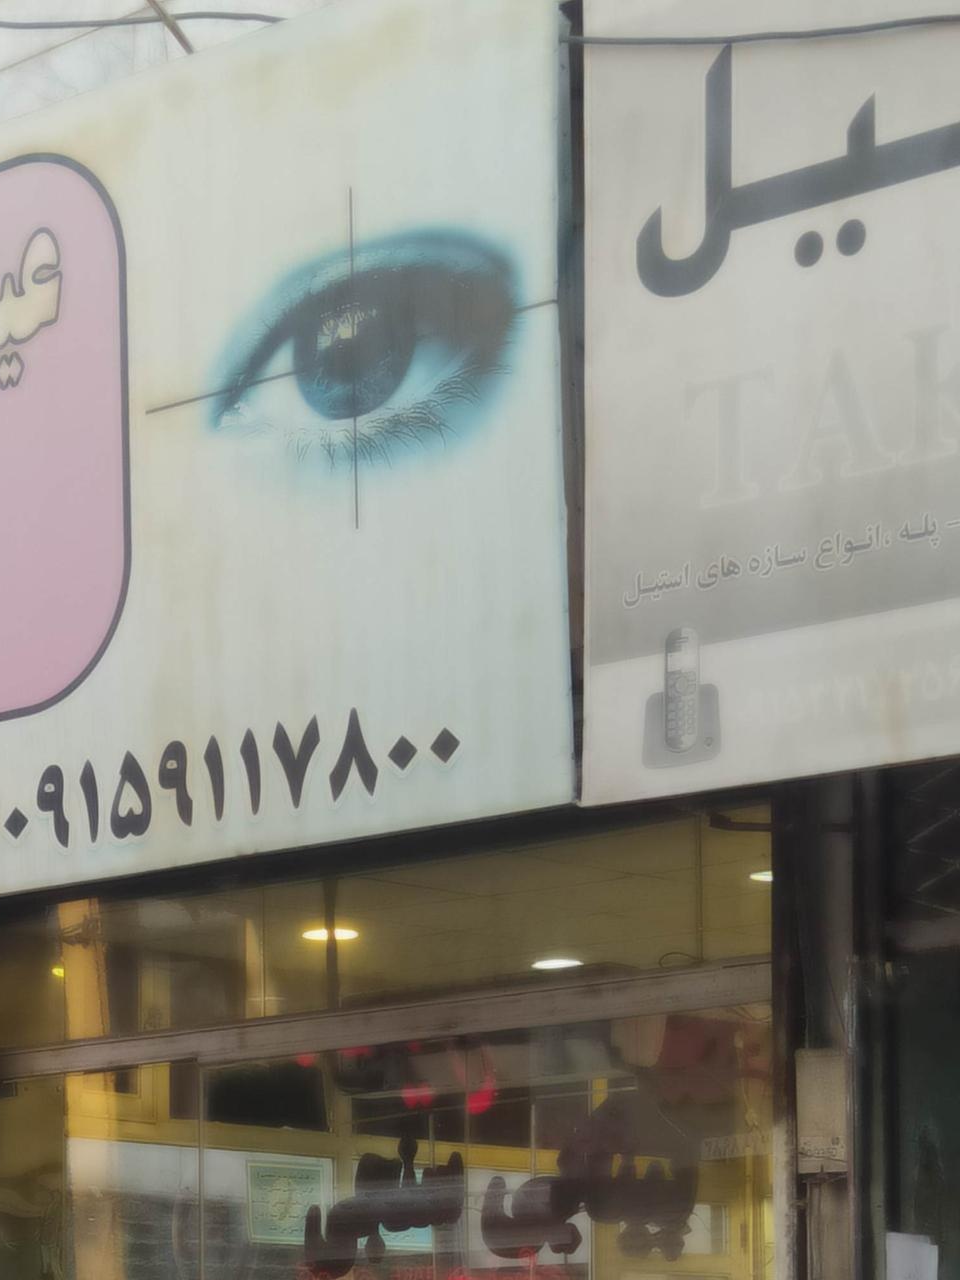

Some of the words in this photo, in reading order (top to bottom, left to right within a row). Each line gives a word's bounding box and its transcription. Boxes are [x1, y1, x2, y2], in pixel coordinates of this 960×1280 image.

[696, 553, 742, 590] های
[747, 542, 807, 577] سازه
[623, 563, 691, 609] استیل
[2, 708, 460, 848] ۰۹۱۵۹۱۱۷۸۰۰
